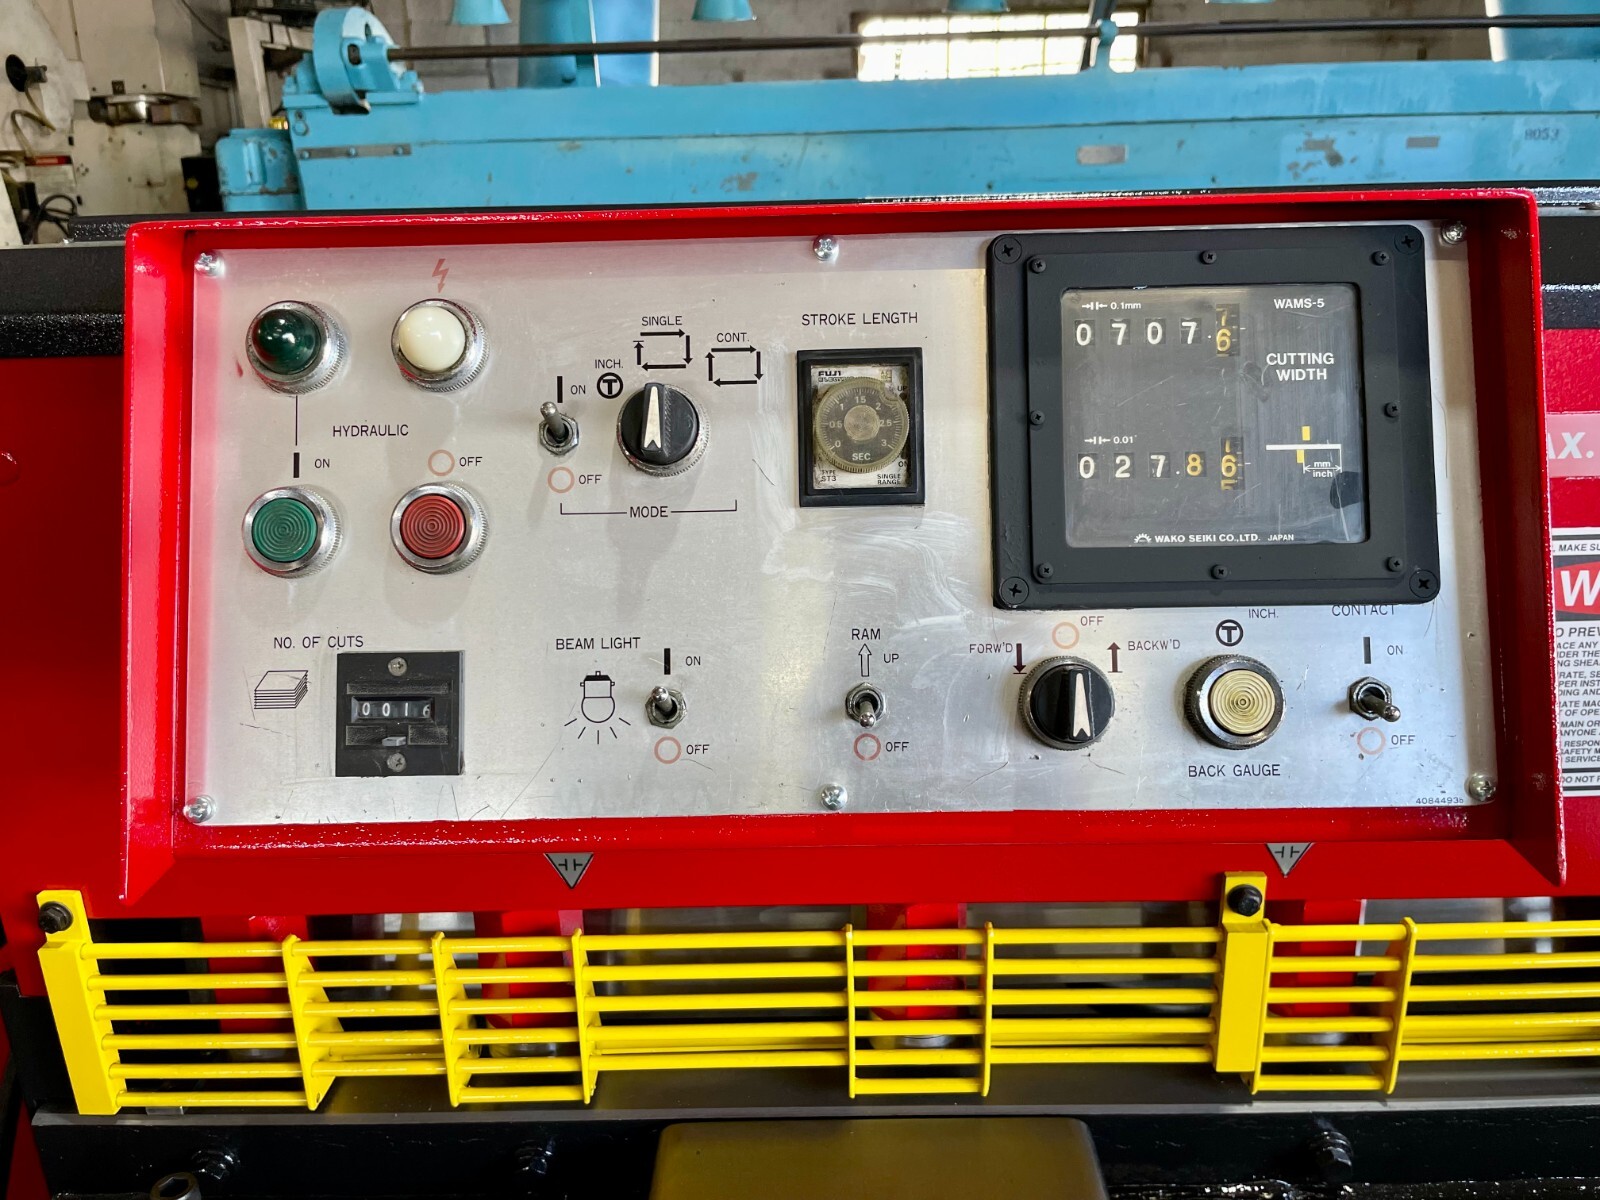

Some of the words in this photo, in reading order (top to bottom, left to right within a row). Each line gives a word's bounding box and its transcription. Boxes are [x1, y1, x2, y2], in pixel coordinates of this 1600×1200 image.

[1110, 302, 1142, 310] 0.1mm
[1273, 298, 1325, 309] WAMS-5
[641, 316, 683, 326] SINGLE
[801, 313, 856, 326] STROKE
[862, 312, 918, 325] LENGTH
[716, 333, 750, 343] CONT.
[594, 359, 624, 369] INCH.
[1266, 353, 1335, 366] CUTTING
[1276, 368, 1328, 381] WIDTH
[570, 385, 586, 395] ON
[875, 403, 881, 411] 2
[332, 424, 409, 437] HYDRAULIC
[314, 458, 330, 469] ON
[459, 457, 483, 467] OFF
[1312, 469, 1333, 478] inch
[578, 475, 602, 485] OFF
[630, 506, 668, 518] MODE
[1155, 535, 1185, 543] WAKO
[1189, 534, 1216, 542] SEIKI
[1248, 609, 1279, 619] INCH.
[1331, 605, 1396, 616] CONTACT
[1080, 616, 1105, 626] OFF
[851, 628, 881, 640] RAM
[273, 636, 295, 649] NO.
[302, 636, 321, 648] OF
[328, 635, 364, 648] CUTS
[556, 638, 595, 650] BEAM
[601, 637, 641, 649] LIGHT
[1128, 639, 1181, 651] BACKW'D
[1578, 641, 1598, 649] ANY
[969, 642, 1013, 654] FORW'D
[1387, 645, 1403, 655] ON
[685, 656, 701, 666] ON
[883, 653, 899, 663] UP
[1565, 708, 1578, 716] OF
[1391, 735, 1416, 745] OFF
[686, 745, 710, 755] OFF
[885, 742, 909, 752] OFF
[1188, 765, 1226, 777] BACK
[1233, 764, 1281, 776] GAUGE
